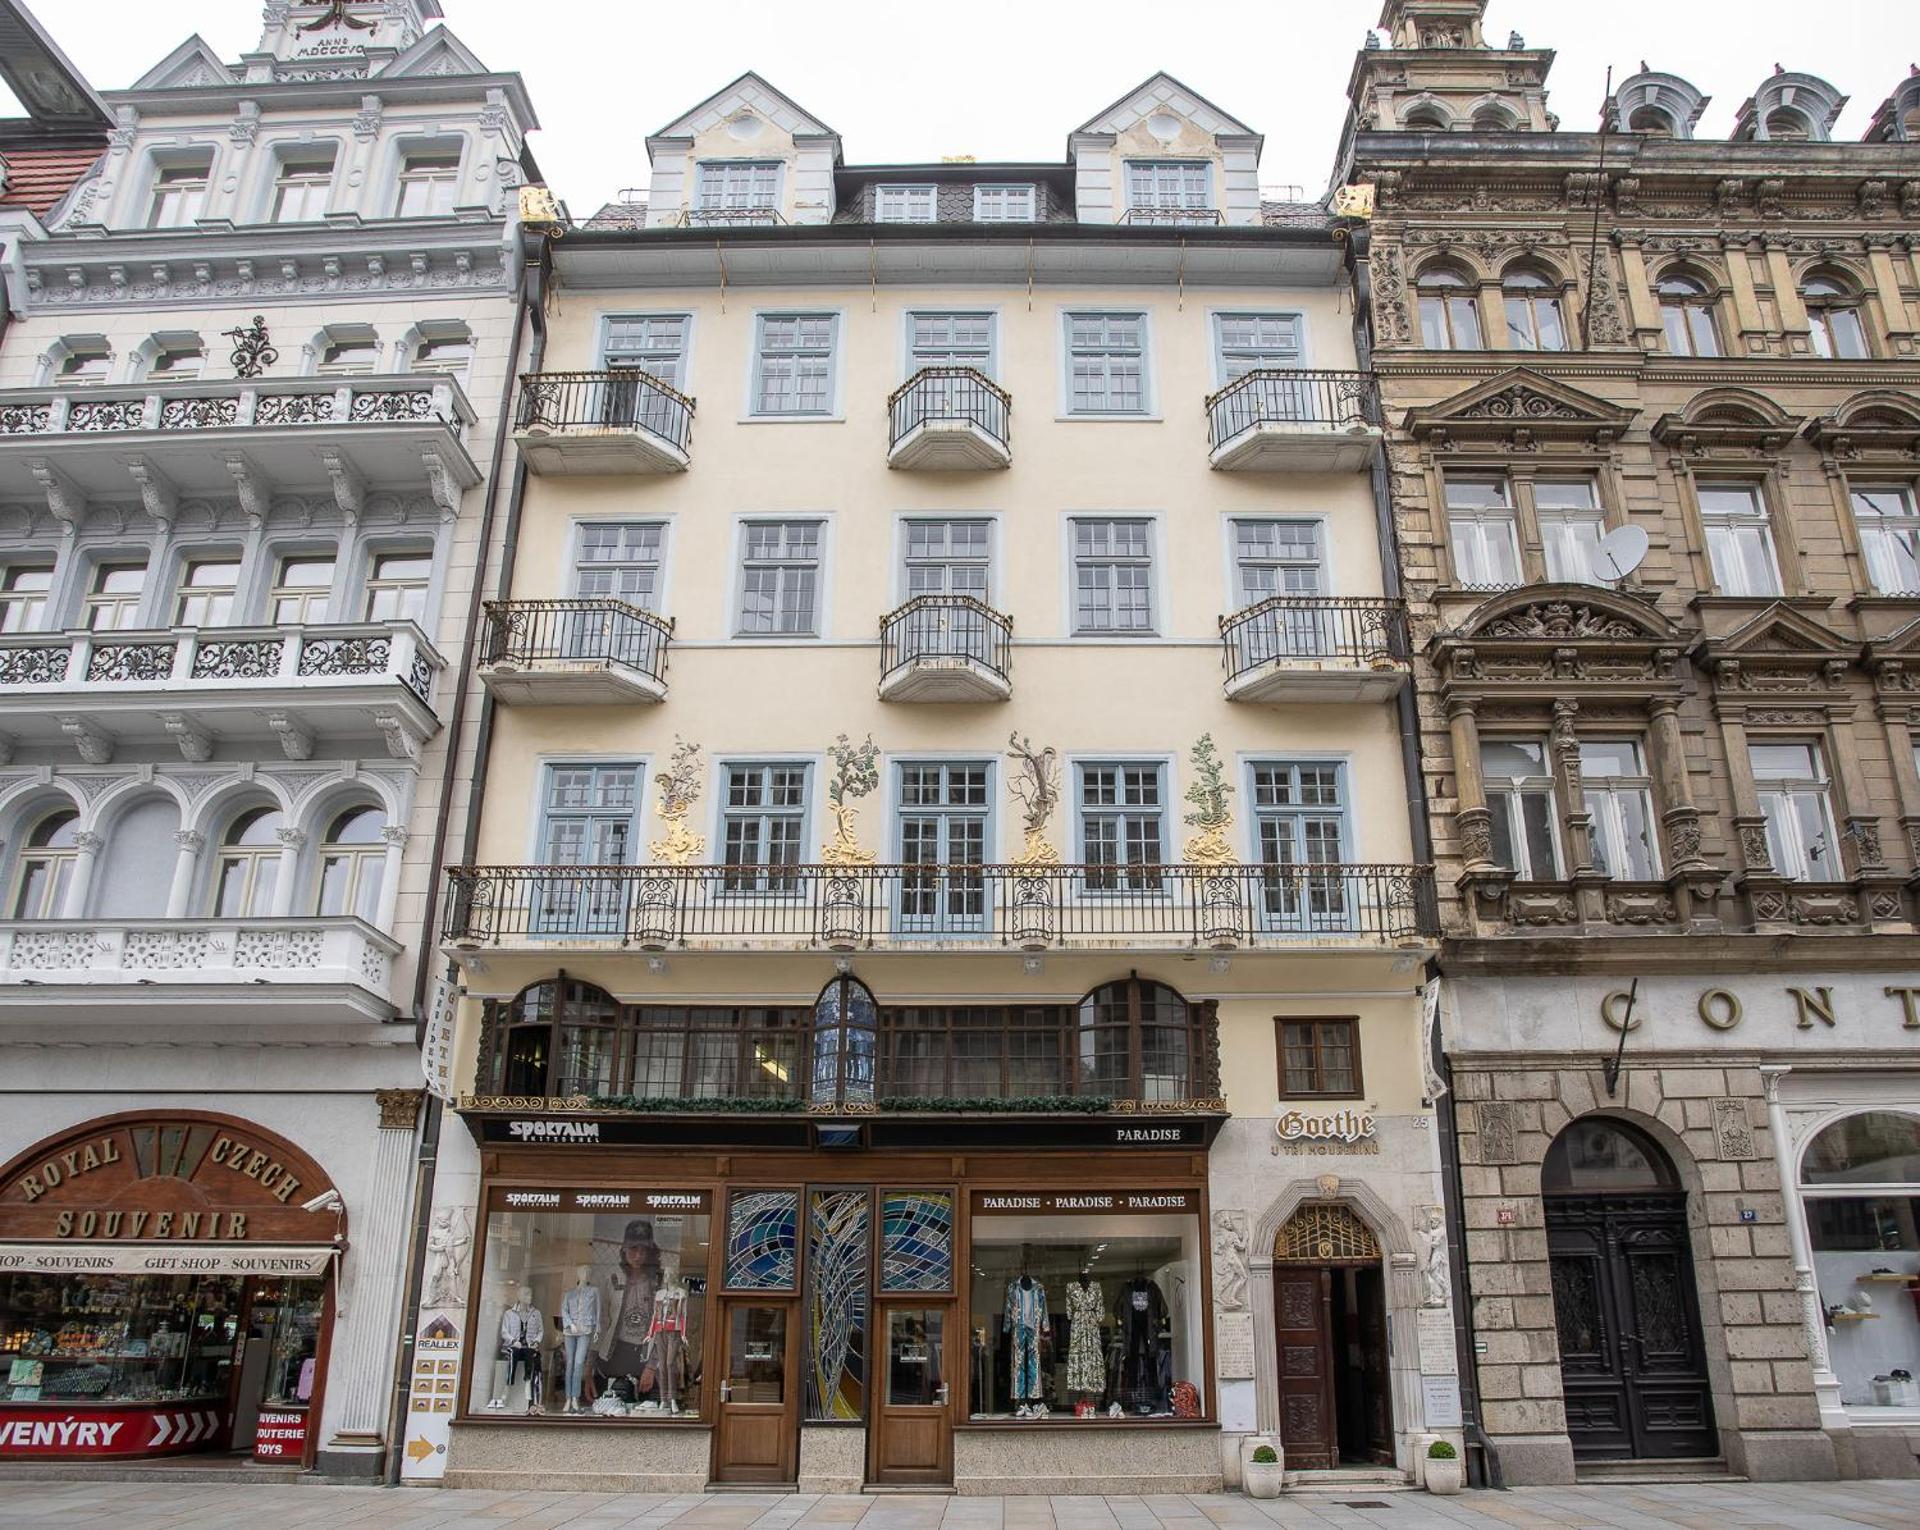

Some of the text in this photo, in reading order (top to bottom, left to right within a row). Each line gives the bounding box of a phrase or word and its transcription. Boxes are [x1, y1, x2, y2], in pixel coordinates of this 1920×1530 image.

[1276, 1108, 1377, 1142] Goethe
[1413, 1117, 1428, 1128] 25
[1117, 1129, 1181, 1141] PARADISE
[20, 1137, 300, 1202] ROYAL CZECH
[983, 1196, 1186, 1208] PARADISE PARADISE PARADISE
[56, 1210, 246, 1238] SOUVENIR
[36, 1256, 114, 1268] SOUVENIRS
[144, 1258, 311, 1270] GIFT SHOP SOUVENIRS
[418, 1340, 459, 1349] REALLEX
[258, 1443, 283, 1454] TOYS
